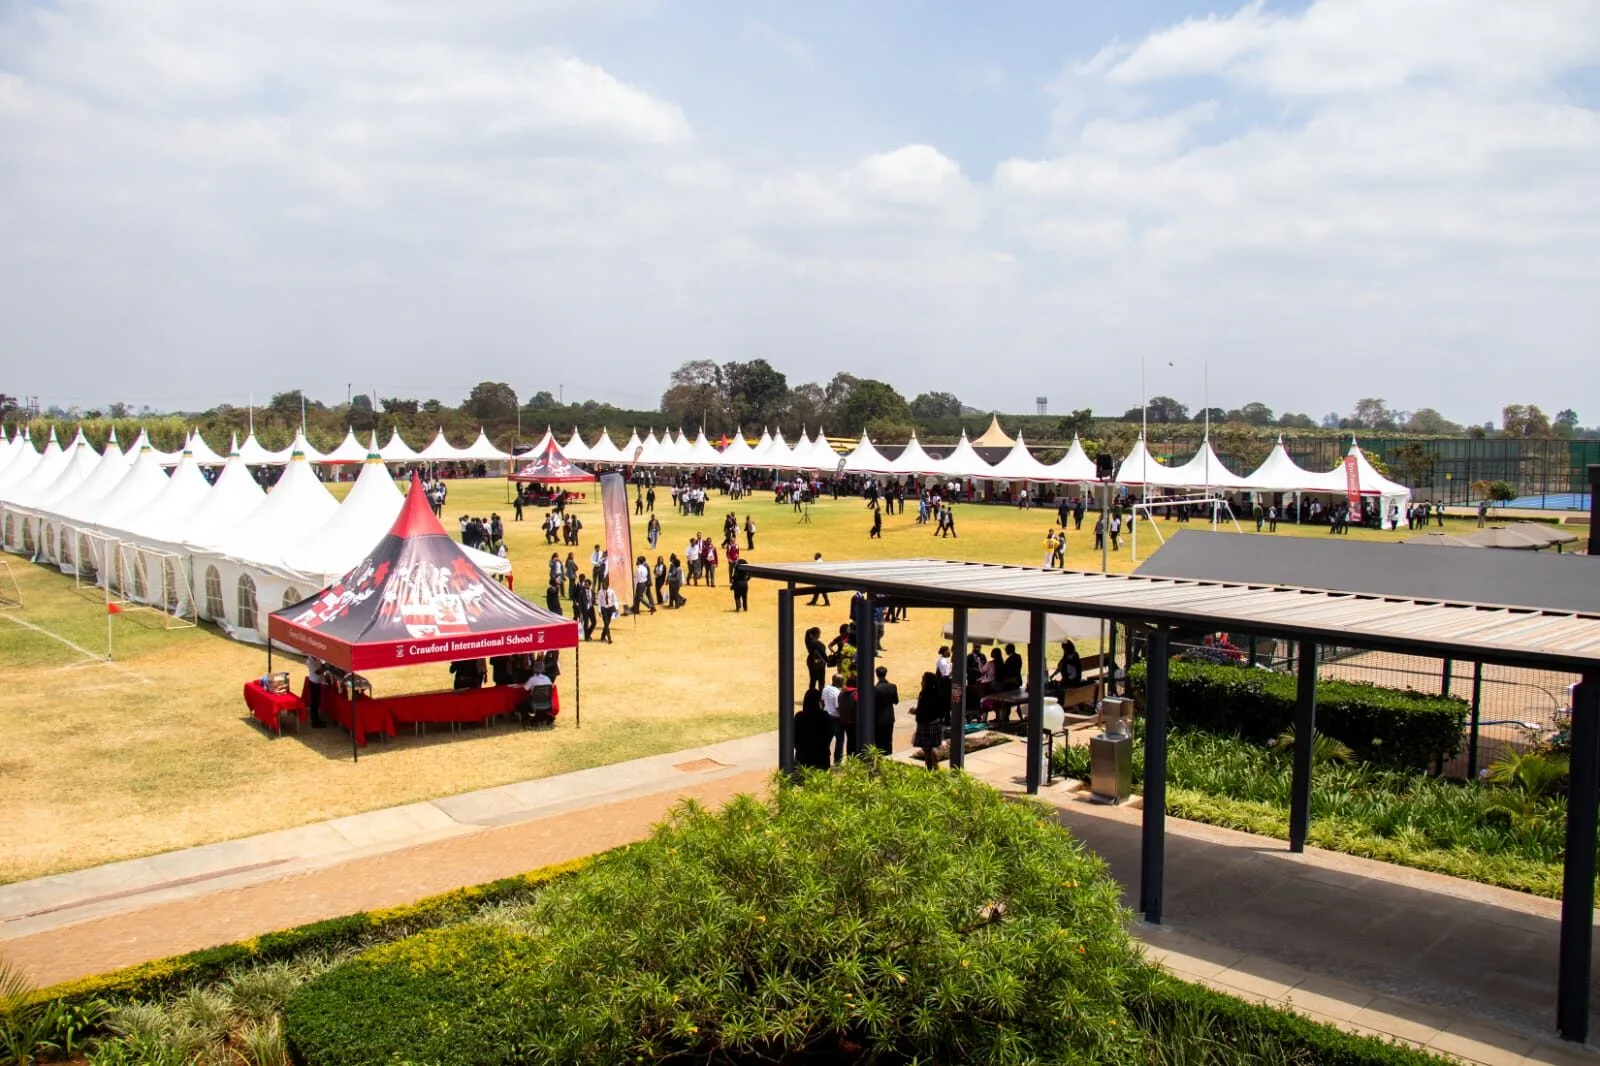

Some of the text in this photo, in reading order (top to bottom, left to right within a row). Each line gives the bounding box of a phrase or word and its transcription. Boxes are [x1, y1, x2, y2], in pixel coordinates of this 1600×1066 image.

[409, 634, 533, 655] Crawford International School
